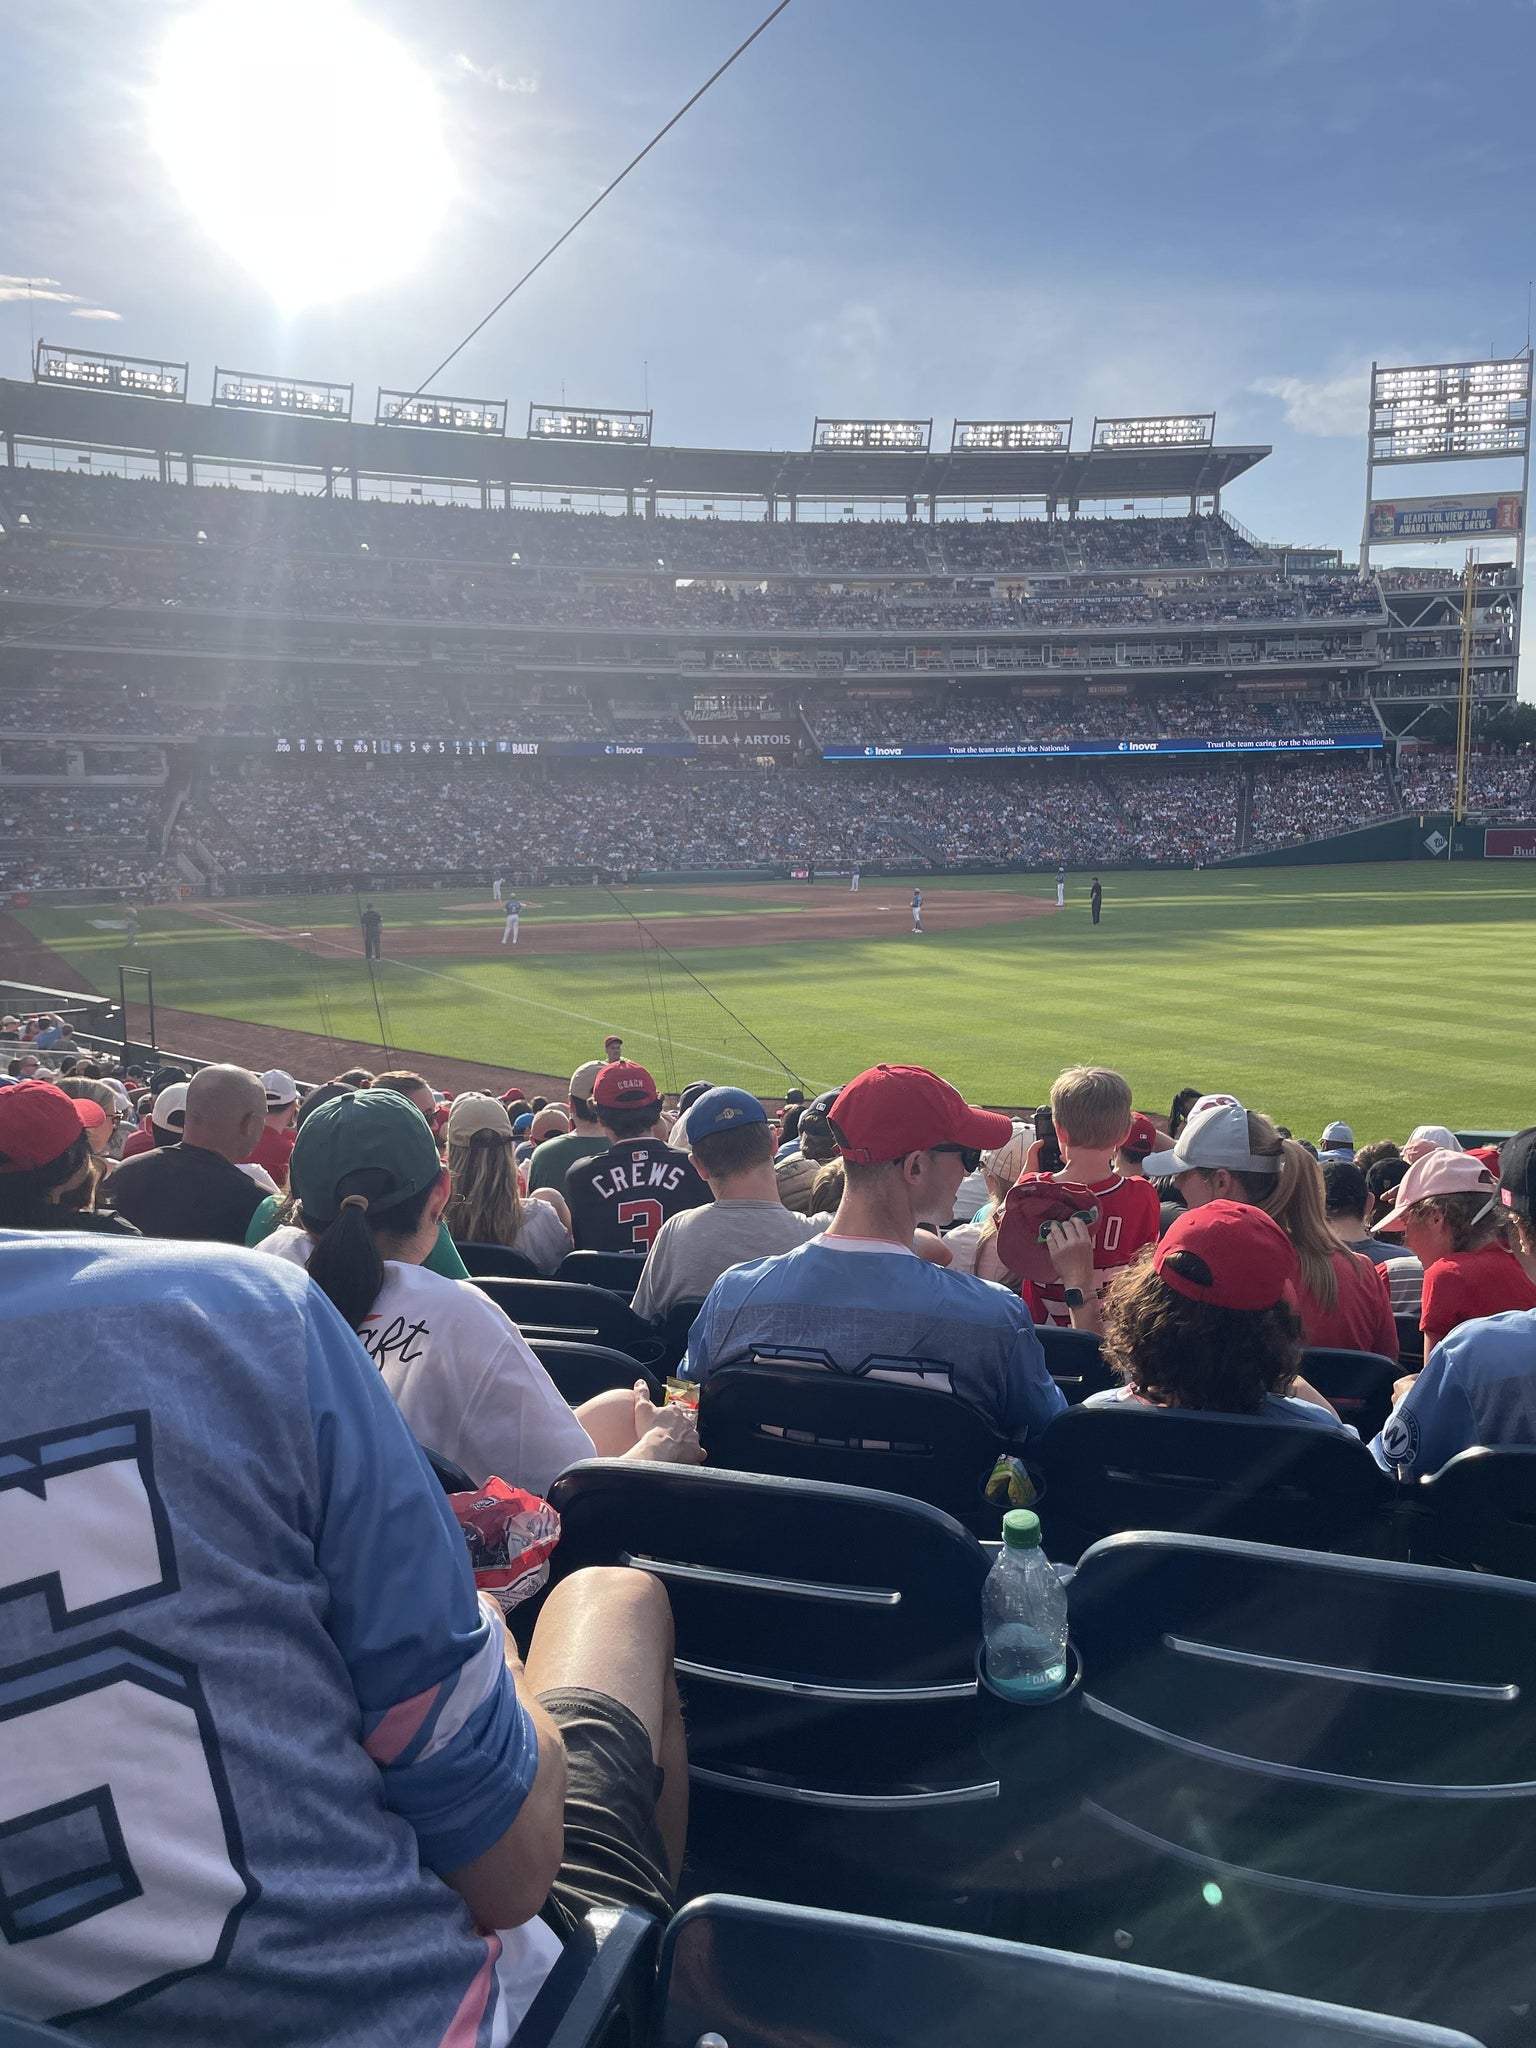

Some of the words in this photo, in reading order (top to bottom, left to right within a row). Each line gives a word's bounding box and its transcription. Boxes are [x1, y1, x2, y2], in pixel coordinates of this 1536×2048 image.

[1403, 512, 1442, 524] BEAUTIFUL
[1445, 511, 1470, 522] VIEWS
[1471, 510, 1488, 520] AND
[1399, 523, 1426, 534] AWARD
[1428, 521, 1462, 533] WINNING
[1465, 519, 1492, 530] BREWS
[744, 734, 791, 745] ARTOIS
[1225, 740, 1236, 748] the
[1237, 740, 1254, 748] team
[1255, 740, 1277, 748] caring
[1278, 739, 1288, 747] for
[1302, 738, 1335, 746] Nationals
[512, 743, 539, 755] BAILEY
[616, 746, 643, 755] Inova
[875, 746, 902, 756] Inova
[949, 746, 966, 754] Trust
[967, 746, 978, 754] the
[995, 746, 1016, 754] caring
[1017, 745, 1027, 753] for
[1039, 744, 1070, 752] Nationals
[1129, 742, 1157, 751] Inova
[617, 1079, 643, 1090] COACH
[591, 1162, 685, 1199] CREWS
[618, 1198, 664, 1255] 3
